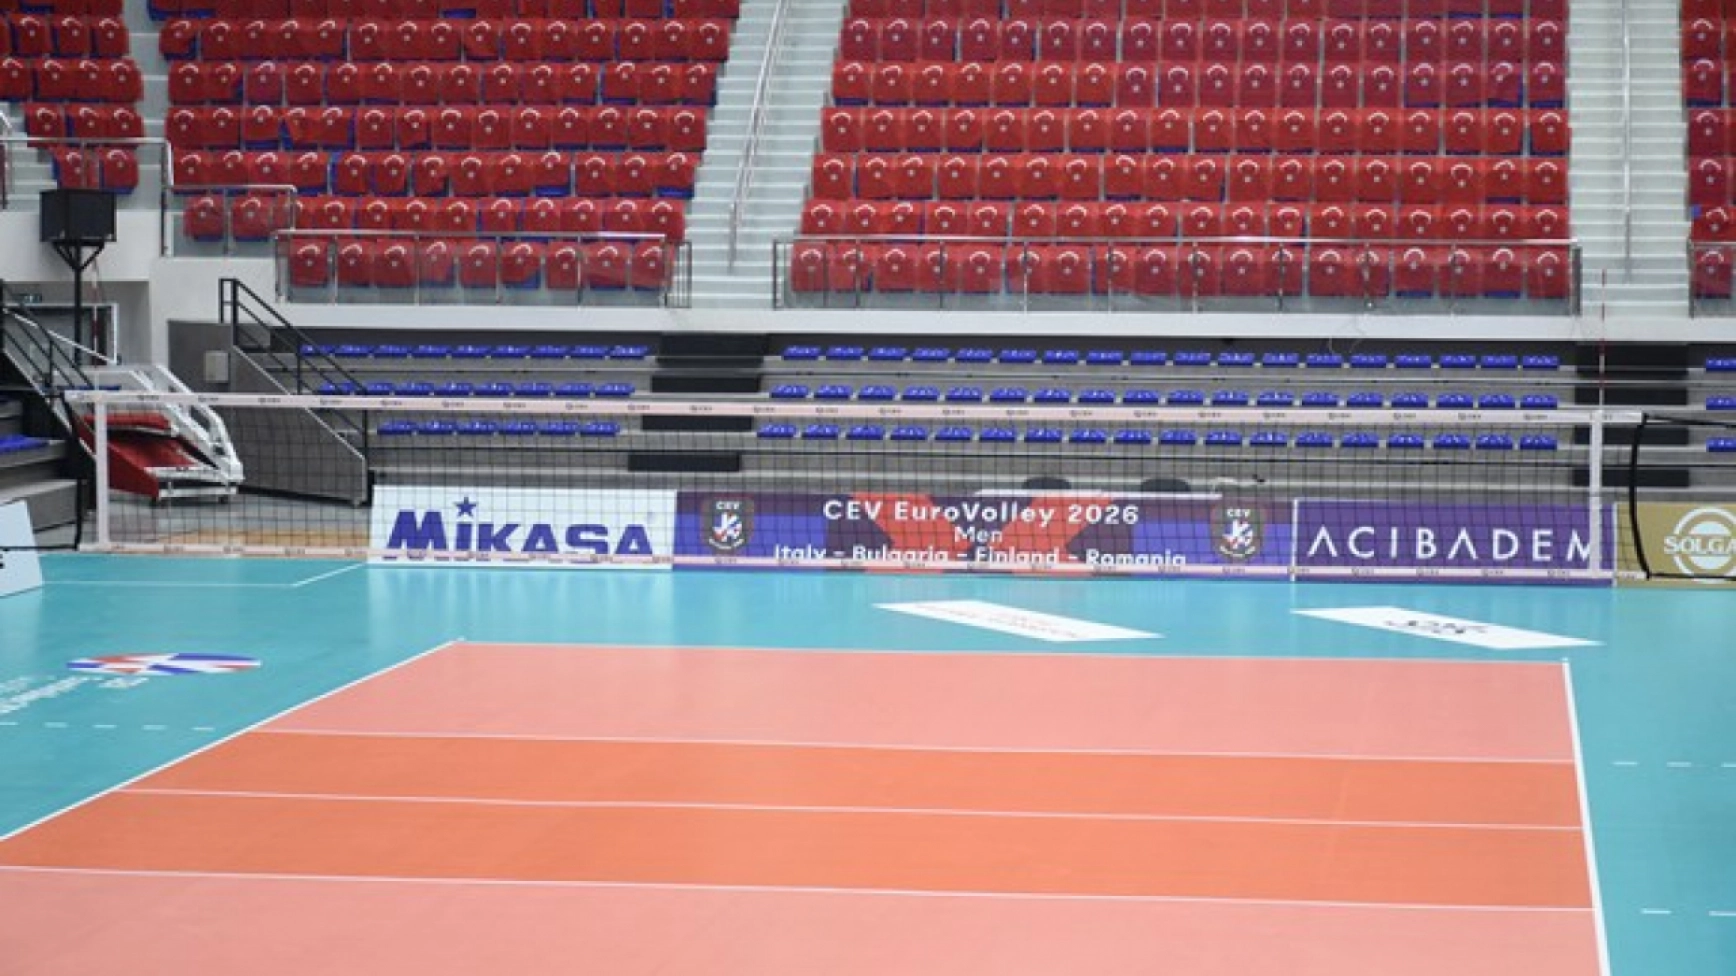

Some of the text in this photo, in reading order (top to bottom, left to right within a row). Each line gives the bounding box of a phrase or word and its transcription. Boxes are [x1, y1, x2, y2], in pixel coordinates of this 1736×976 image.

[823, 500, 1139, 526] CEV EuroVolley 2026
[954, 526, 1003, 543] Men
[775, 543, 827, 561] Italy
[975, 547, 1059, 565] Finland
[1085, 549, 1187, 567] Romania
